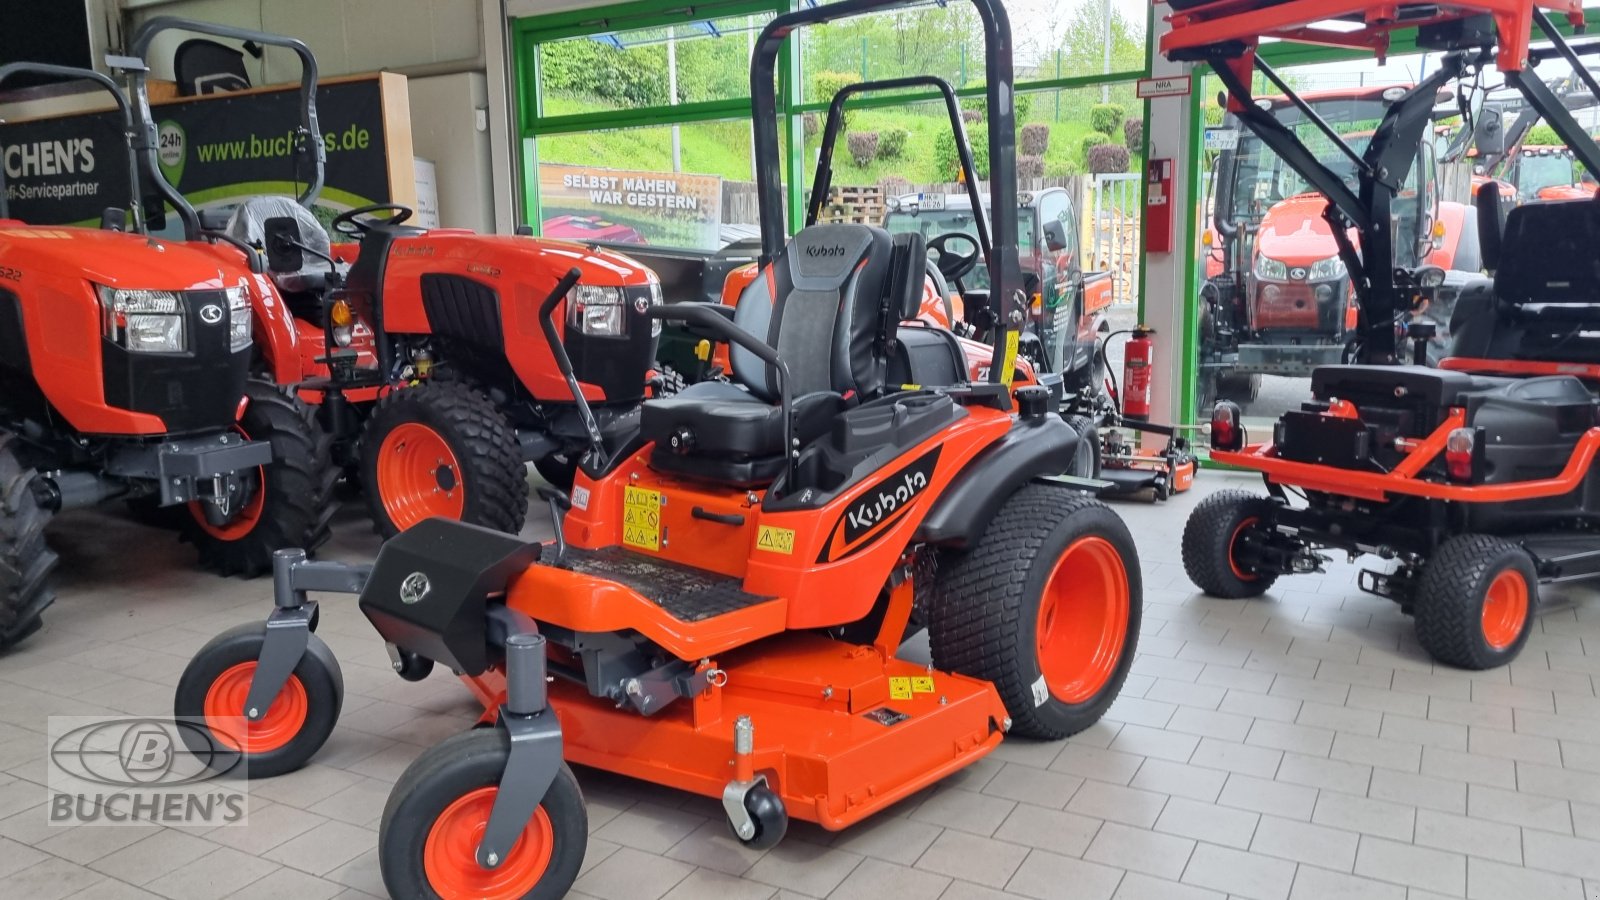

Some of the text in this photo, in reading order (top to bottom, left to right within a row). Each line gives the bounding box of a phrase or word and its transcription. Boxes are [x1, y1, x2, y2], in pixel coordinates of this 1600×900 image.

[161, 133, 181, 148] 24h
[563, 174, 676, 193] SELBST MÄHEN
[589, 190, 697, 209] WAR GESTERN
[806, 244, 845, 257] Kubota
[848, 471, 927, 529] Kubota
